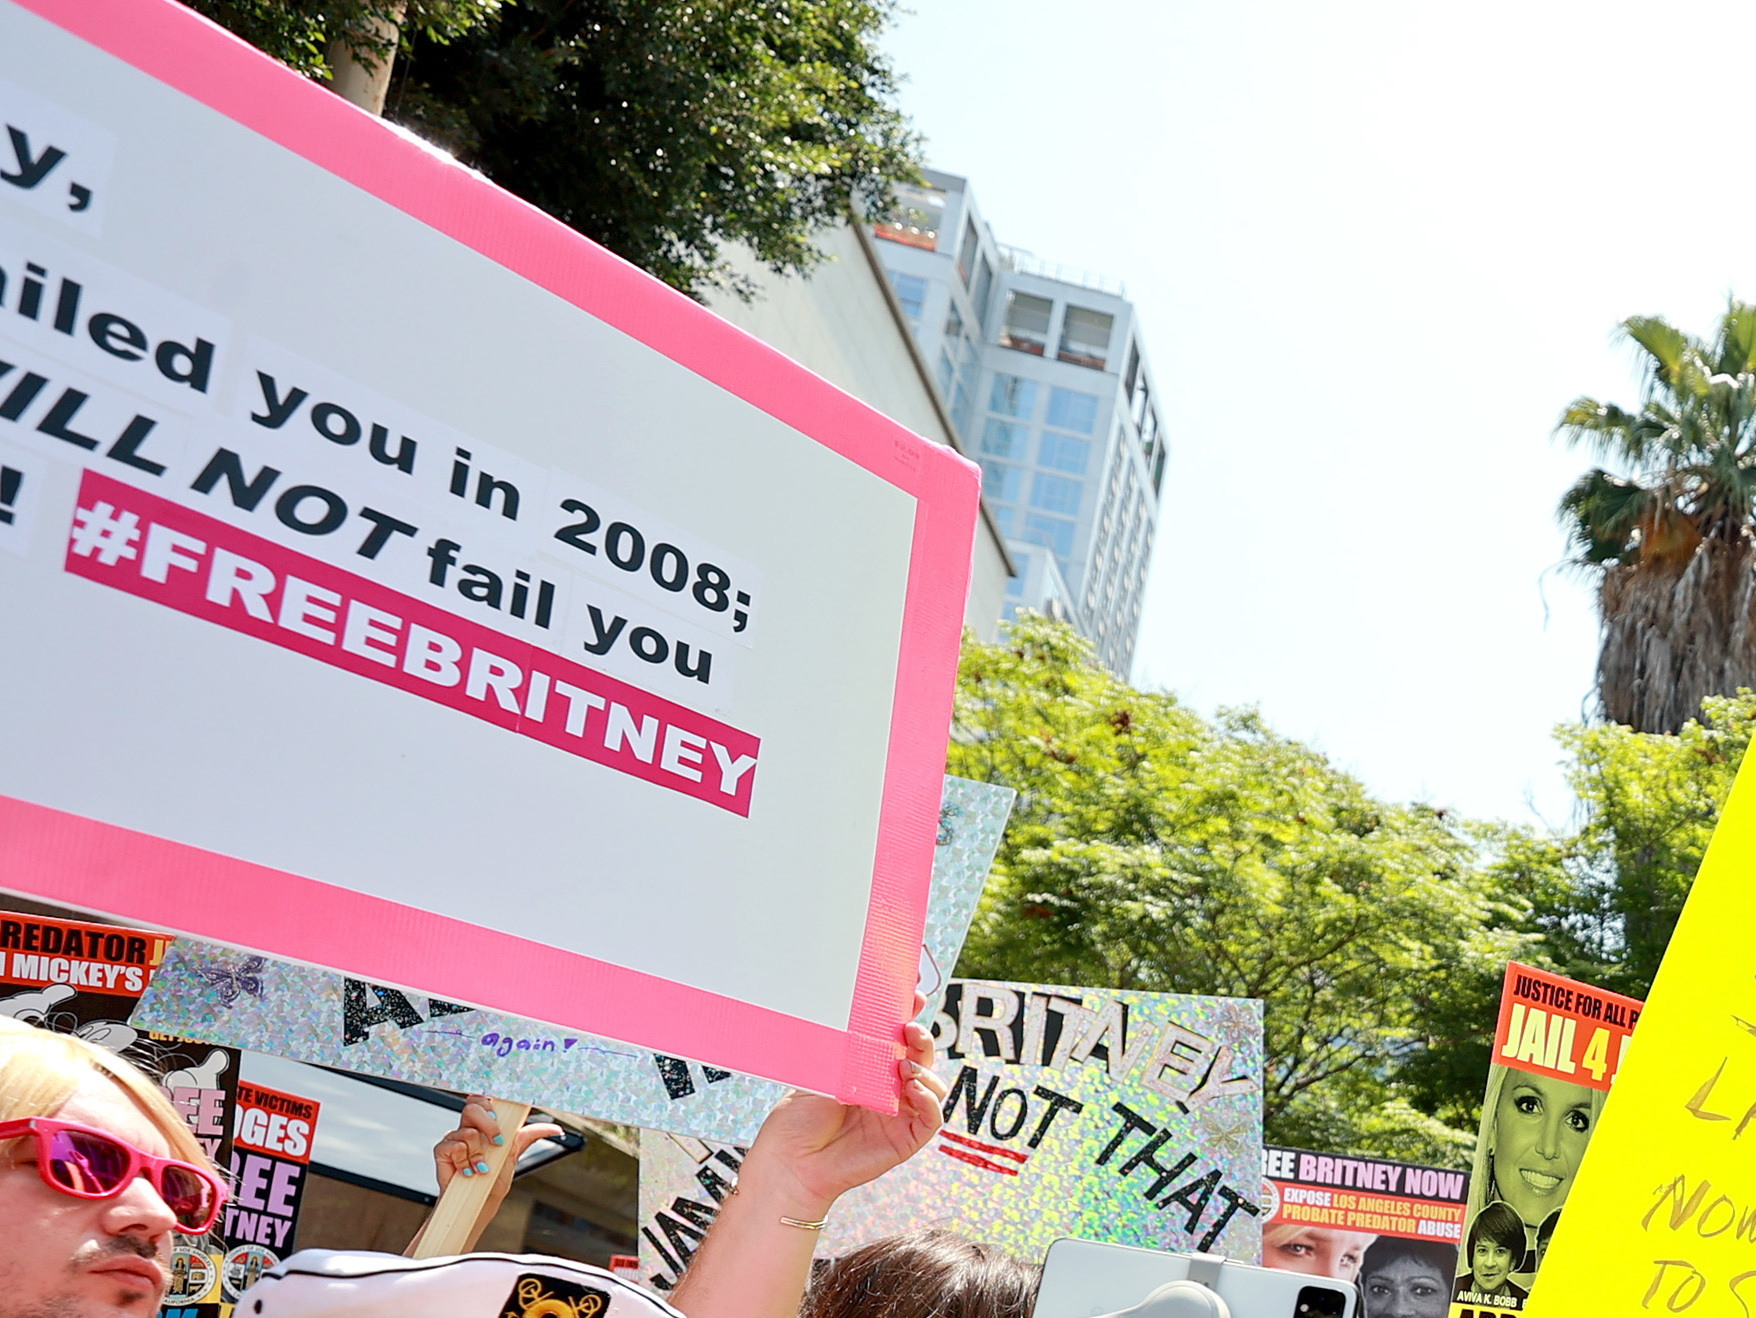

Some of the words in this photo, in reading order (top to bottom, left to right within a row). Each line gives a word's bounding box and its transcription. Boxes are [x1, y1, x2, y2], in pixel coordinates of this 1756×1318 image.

[0, 261, 215, 394] iled
[250, 369, 416, 476] you
[449, 446, 520, 521] in
[553, 497, 752, 634] 2008;
[0, 359, 167, 477] ILL
[190, 447, 418, 562] NOT
[428, 538, 556, 630] fail
[584, 603, 713, 684] you
[70, 498, 758, 798] #FREEBRITNEY
[12, 953, 143, 992] MICKEY'S
[1513, 975, 1574, 1012] JUSTICE
[1574, 992, 1602, 1020] FOR
[1603, 1003, 1626, 1026] ALL
[1501, 1003, 1577, 1074] JAIL
[1582, 1027, 1611, 1081] 4
[255, 1090, 313, 1119] VICTIMS
[944, 1066, 1083, 1149] NOT
[1095, 1102, 1260, 1253] THAT
[1299, 1153, 1402, 1192] BRITNEY
[1404, 1168, 1464, 1200] NOW
[1282, 1203, 1345, 1226] PROBATE
[1346, 1211, 1416, 1234] PREDATOR
[1417, 1220, 1461, 1239] ABUSE
[1283, 1187, 1331, 1206] EXPOSE
[1332, 1194, 1357, 1210] LOS
[1357, 1197, 1410, 1217] ANGELES
[1412, 1203, 1462, 1222] COUNTY
[1457, 1290, 1482, 1303] AVIVA
[1493, 1295, 1517, 1308] BOBB
[1642, 1260, 1706, 1312] TO
